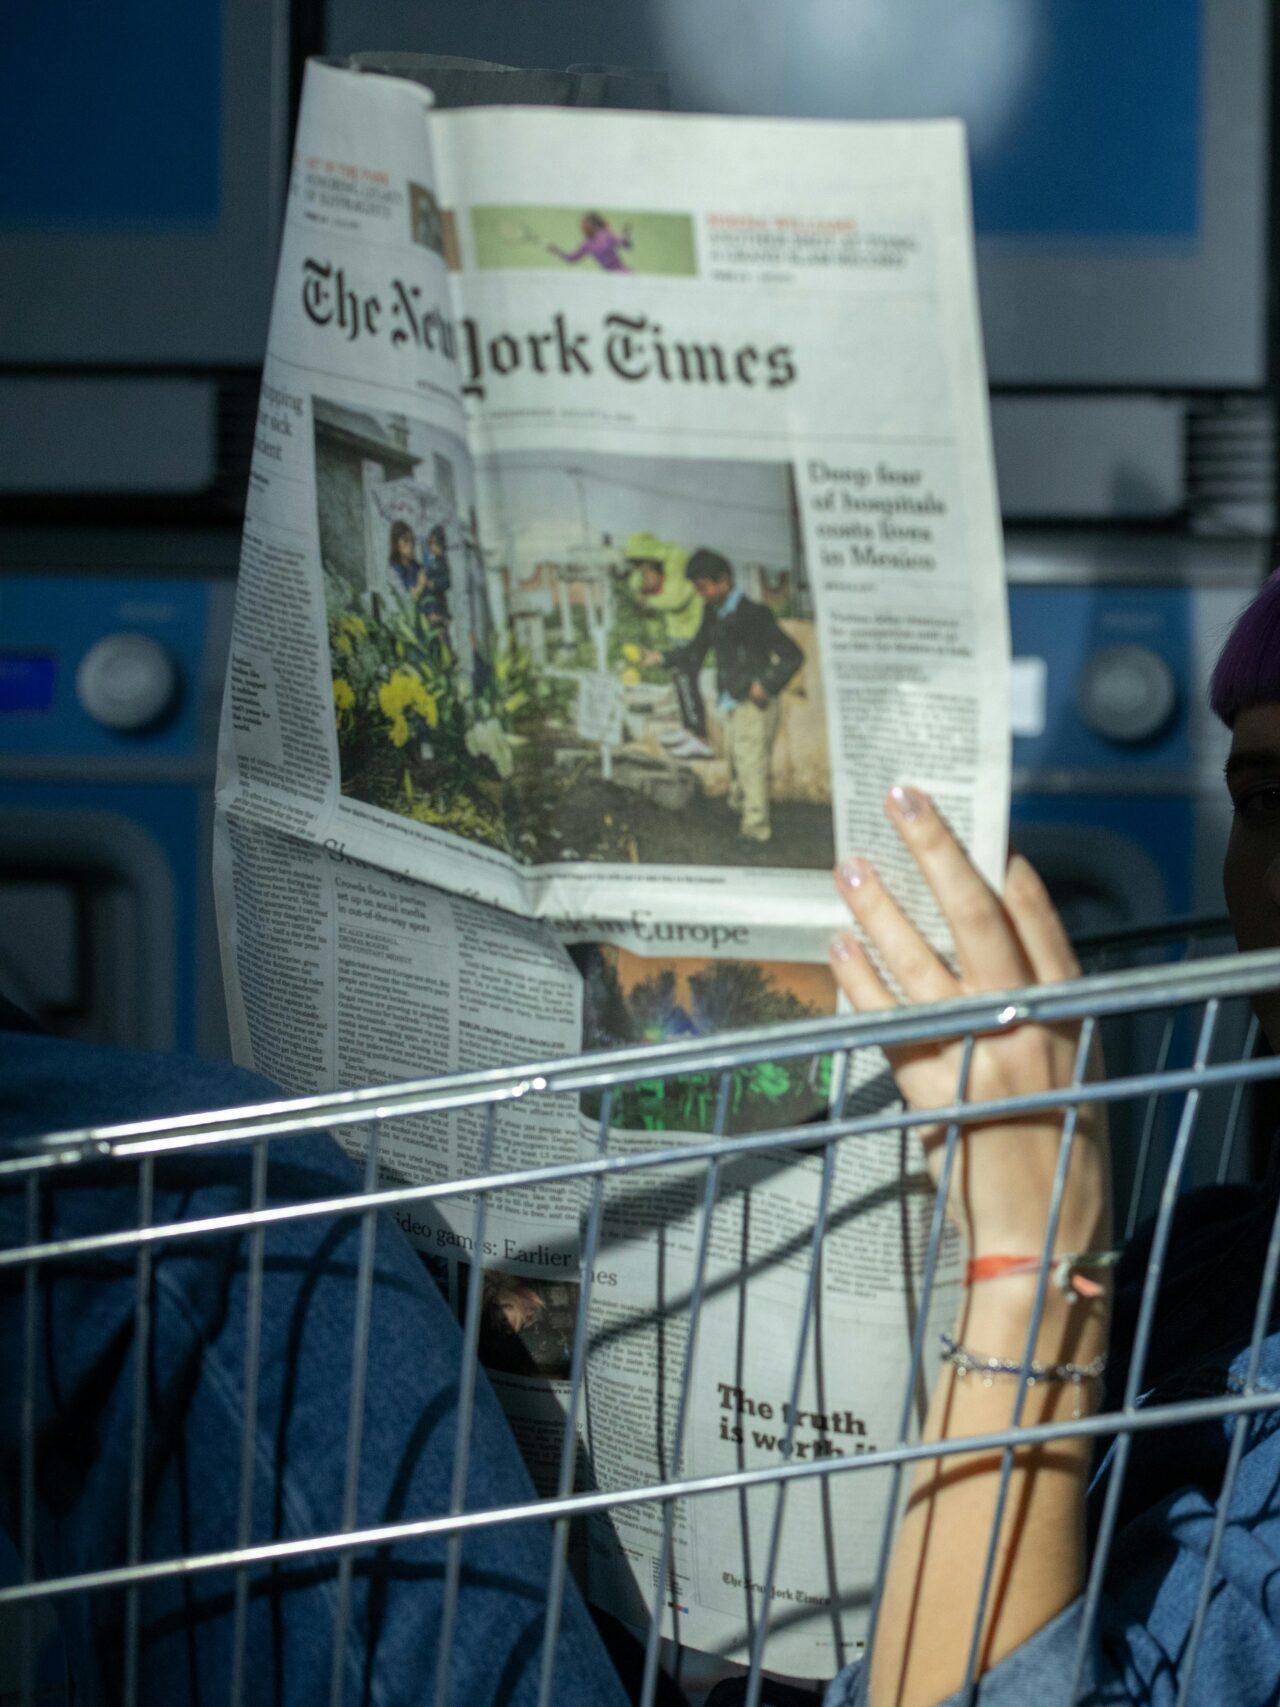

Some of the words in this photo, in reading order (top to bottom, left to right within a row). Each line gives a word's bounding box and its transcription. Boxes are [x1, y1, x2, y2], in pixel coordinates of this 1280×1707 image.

[300, 256, 381, 342] The
[603, 311, 798, 391] Times
[806, 461, 871, 490] Deep
[875, 462, 924, 487] fear
[811, 489, 837, 512] of
[841, 490, 947, 519] hospitals
[815, 521, 875, 542] costs
[878, 518, 933, 542] lives
[820, 546, 845, 567] in
[849, 545, 938, 571] Mexico
[335, 877, 367, 893] Crowds
[367, 885, 387, 897] flock
[388, 890, 398, 900] to
[399, 894, 427, 907] parties
[336, 893, 349, 902] set
[350, 896, 362, 907] up
[363, 899, 374, 908] on
[376, 902, 399, 913] social
[400, 907, 426, 919] media
[337, 904, 346, 914] in
[348, 908, 407, 930] out-of-the-way
[408, 922, 431, 933] spots
[337, 926, 347, 934] BY
[631, 909, 749, 949] Europe
[393, 1212, 431, 1239] ideo
[436, 1228, 498, 1256] gams:
[503, 1238, 572, 1267] Earlier
[718, 1383, 774, 1421] The
[719, 1416, 744, 1444] is
[722, 1571, 742, 1588] The
